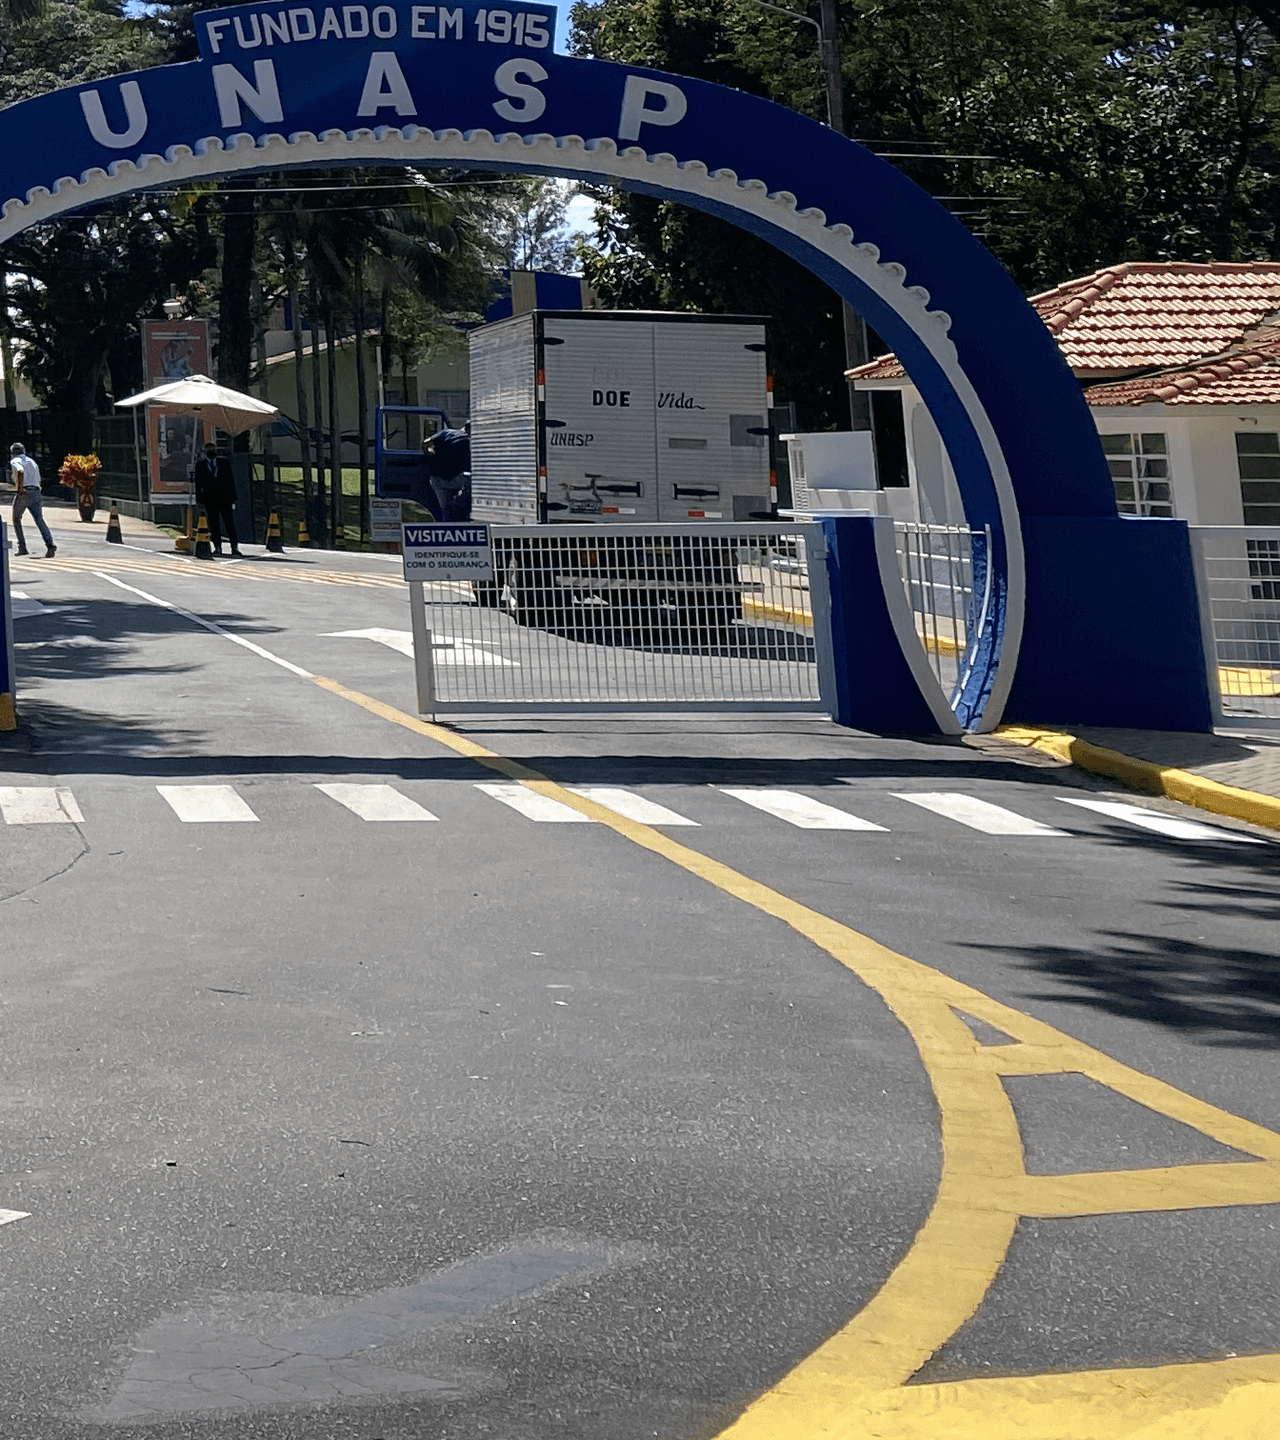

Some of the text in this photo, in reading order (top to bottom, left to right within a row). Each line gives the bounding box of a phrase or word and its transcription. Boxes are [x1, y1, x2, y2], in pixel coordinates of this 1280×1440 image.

[206, 5, 551, 54] FUNDADO EM 1915
[592, 389, 706, 410] DOE Vida
[550, 433, 594, 447] UNASP
[406, 529, 487, 542] VISITANTE
[414, 551, 480, 559] IDENTIFIQUE-SE
[406, 561, 490, 570] COM O SEGURANÇA
